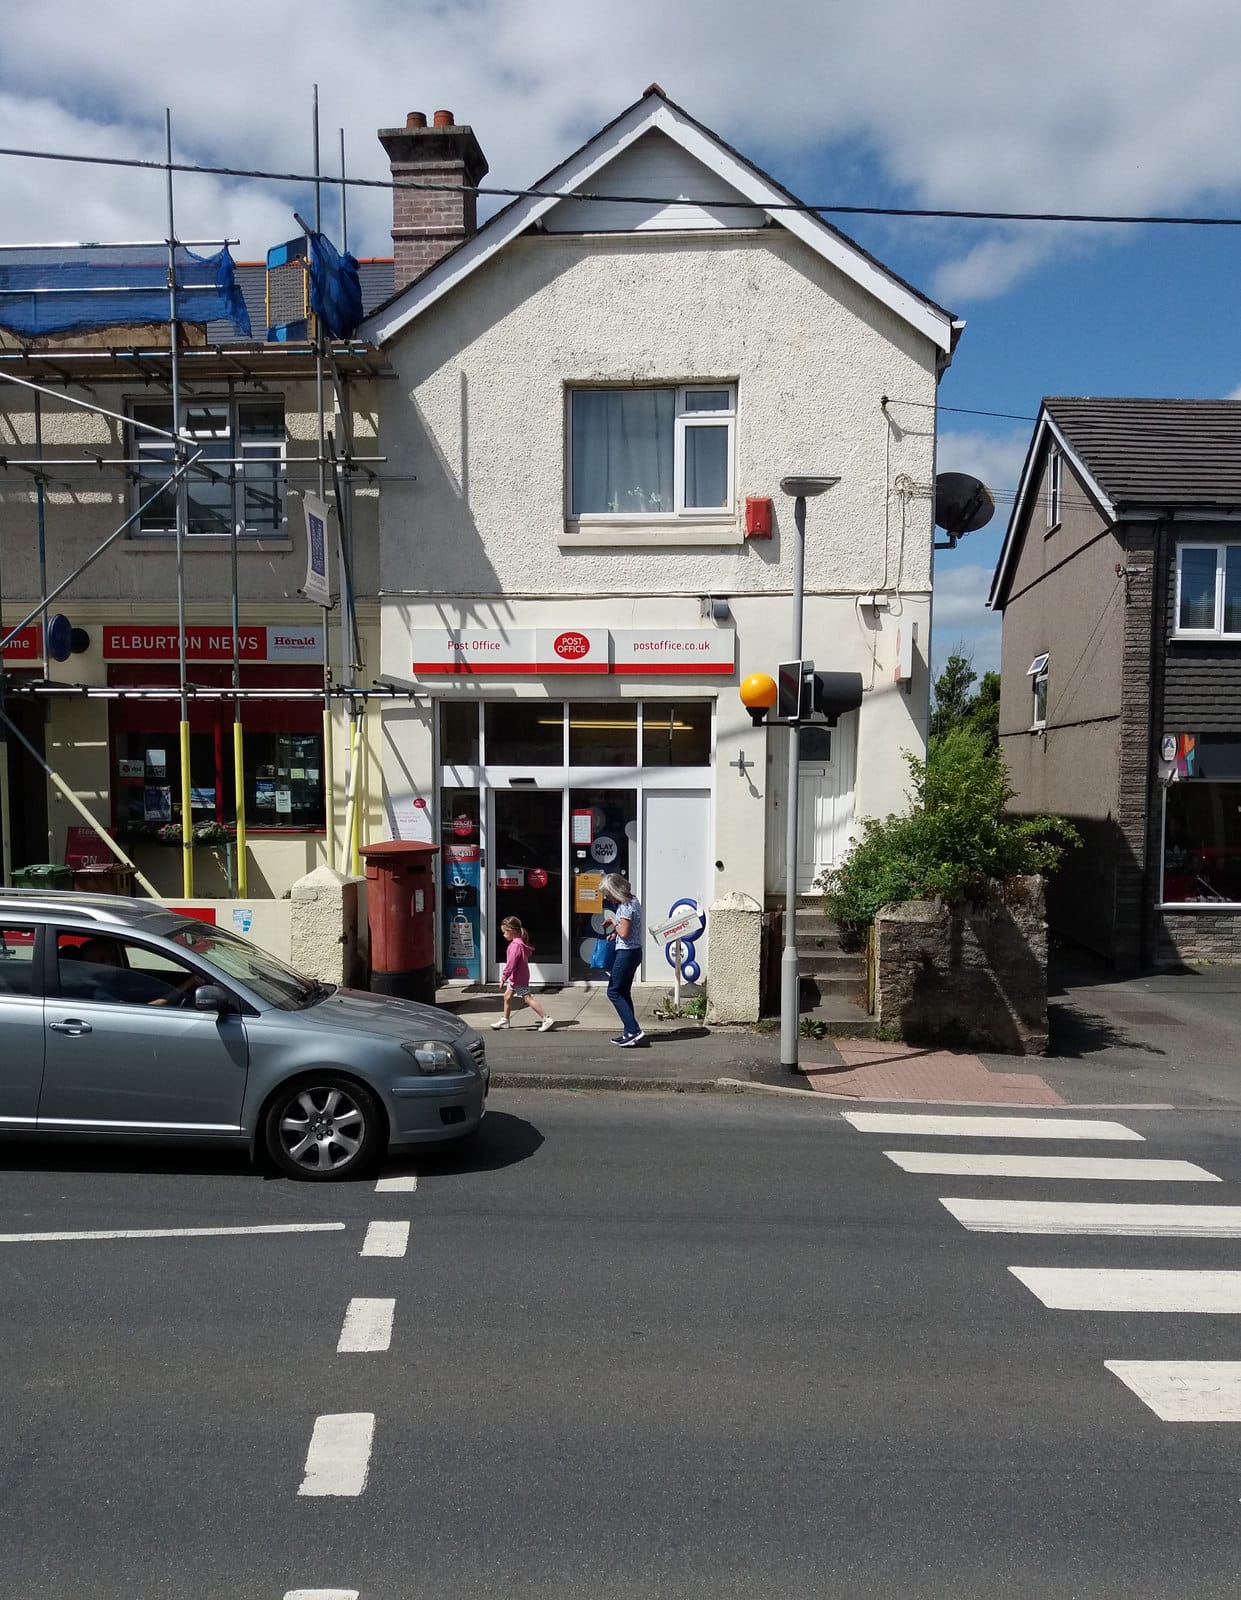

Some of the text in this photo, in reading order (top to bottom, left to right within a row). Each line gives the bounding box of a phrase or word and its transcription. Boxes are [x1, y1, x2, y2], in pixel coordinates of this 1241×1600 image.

[111, 636, 259, 650] ELBURTON NEWS
[274, 636, 316, 646] Herald
[447, 640, 501, 650] Post Office
[562, 637, 583, 646] POST
[633, 640, 711, 652] postoffice.co.uk
[557, 645, 586, 653] OFFICE
